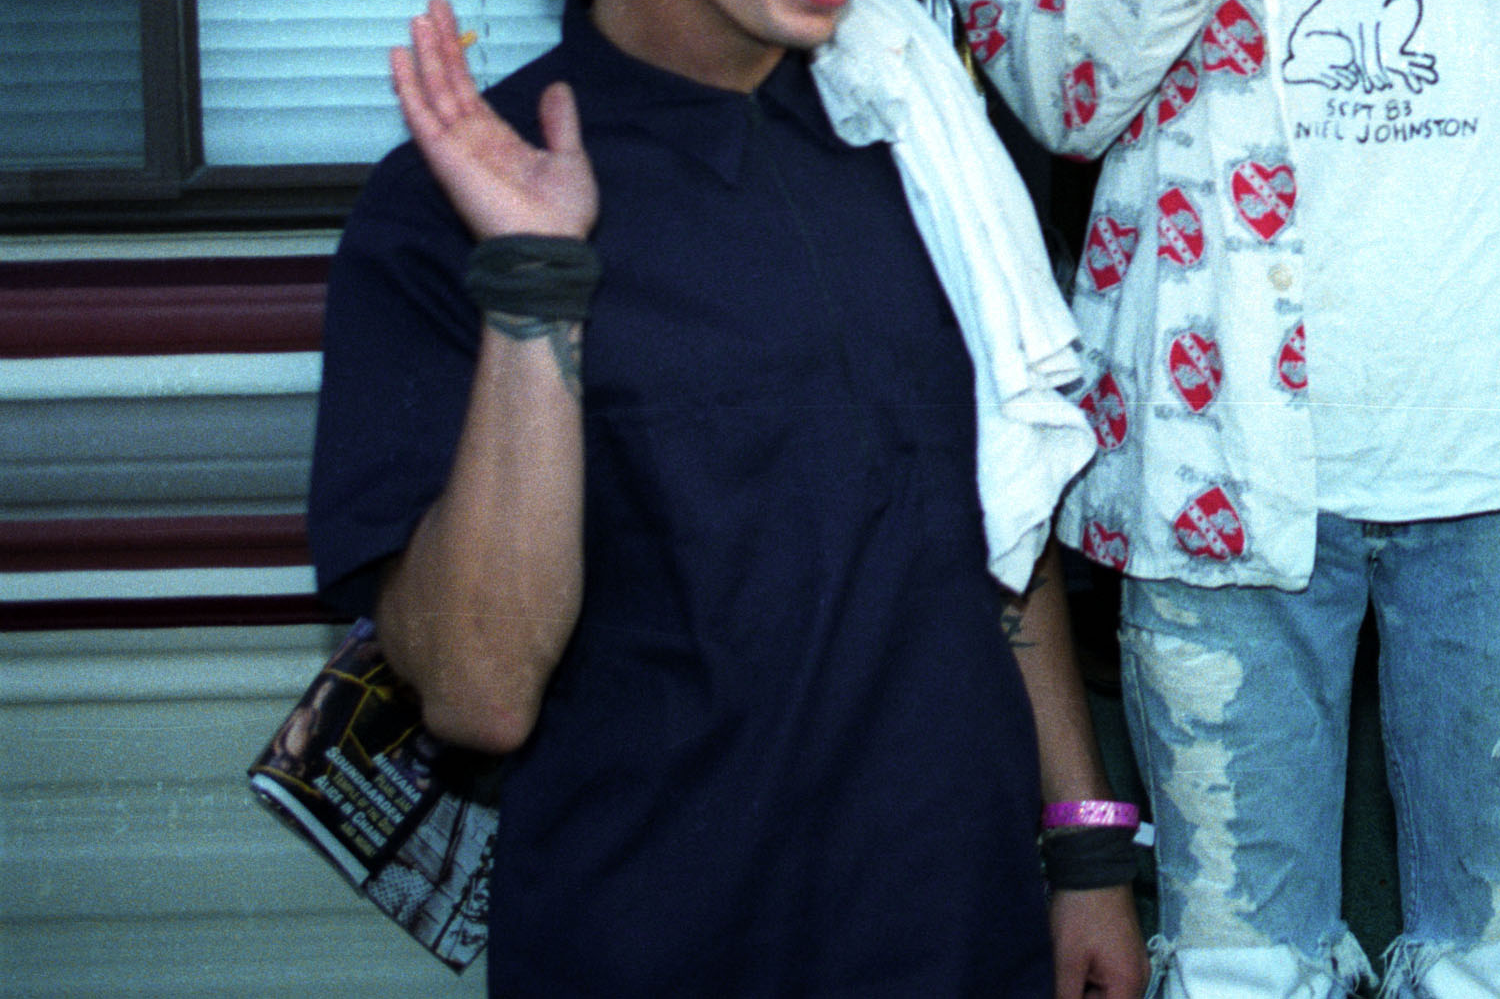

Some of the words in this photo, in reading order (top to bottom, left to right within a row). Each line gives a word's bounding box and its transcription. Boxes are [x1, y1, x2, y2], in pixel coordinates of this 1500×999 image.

[1385, 98, 1413, 121] 83
[1294, 121, 1345, 141] NIEL
[1356, 117, 1479, 145] JOHNSTON
